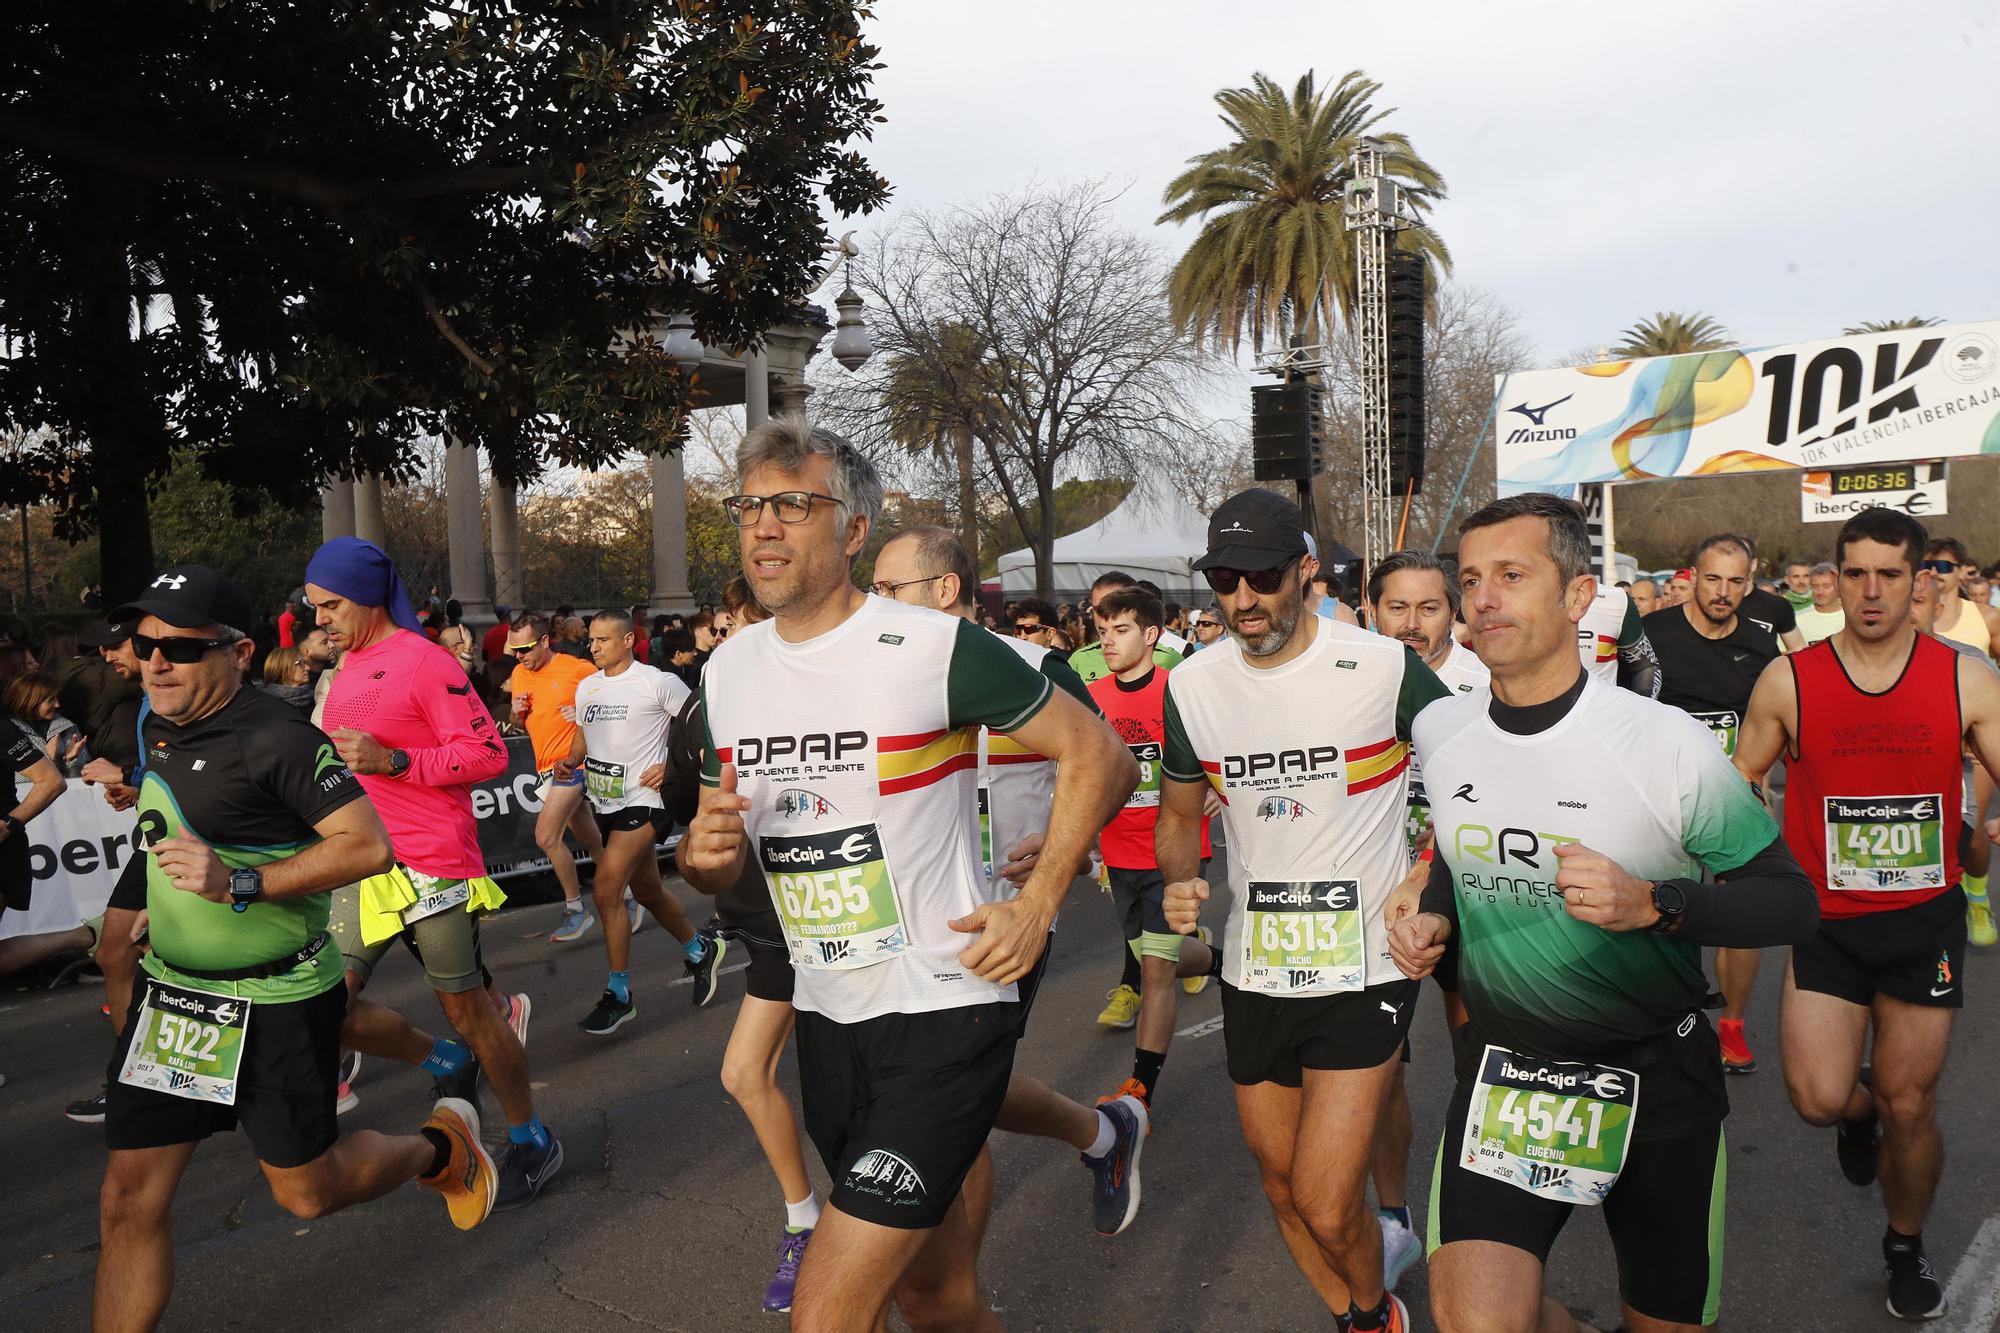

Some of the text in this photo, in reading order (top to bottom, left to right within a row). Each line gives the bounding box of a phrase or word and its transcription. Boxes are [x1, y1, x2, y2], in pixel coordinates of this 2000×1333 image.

[1761, 337, 1946, 447] 10K
[1801, 385, 2000, 466] 10K VALENCIA IBERCAJA
[1838, 472, 1908, 493] 0:06:36
[1833, 724, 1933, 745] WONG
[738, 730, 868, 767] DPAP
[1832, 746, 1933, 757] PERFORMANCE
[738, 770, 749, 778] DE
[755, 766, 799, 777] PUENTE
[818, 763, 866, 773] PUENTE
[1224, 745, 1339, 779] DPAP
[1241, 777, 1280, 788] PUENTE
[1296, 771, 1338, 782] PUENTE
[1839, 805, 1899, 820] iberCaja
[1847, 824, 1923, 856] 4201
[767, 845, 825, 865] iberCaja
[1877, 870, 1907, 887] 10K
[779, 867, 870, 919] 6255
[1255, 890, 1312, 907] iberCaja
[1261, 913, 1338, 951] 6313
[819, 939, 850, 963] 10K
[1286, 956, 1312, 965] NACHO
[1288, 970, 1320, 988] 10K
[159, 990, 205, 1015] iberCaja
[157, 1013, 221, 1062] 5122
[167, 1056, 184, 1067] RAFA
[169, 1071, 195, 1089] 10K
[1501, 1062, 1577, 1090] iberCaja
[1498, 1090, 1604, 1149] 4541
[1480, 1147, 1504, 1160] BOX 6
[1526, 1144, 1565, 1161] EUGENIO
[1528, 1161, 1569, 1188] 10K
[856, 1185, 884, 1196] puente
